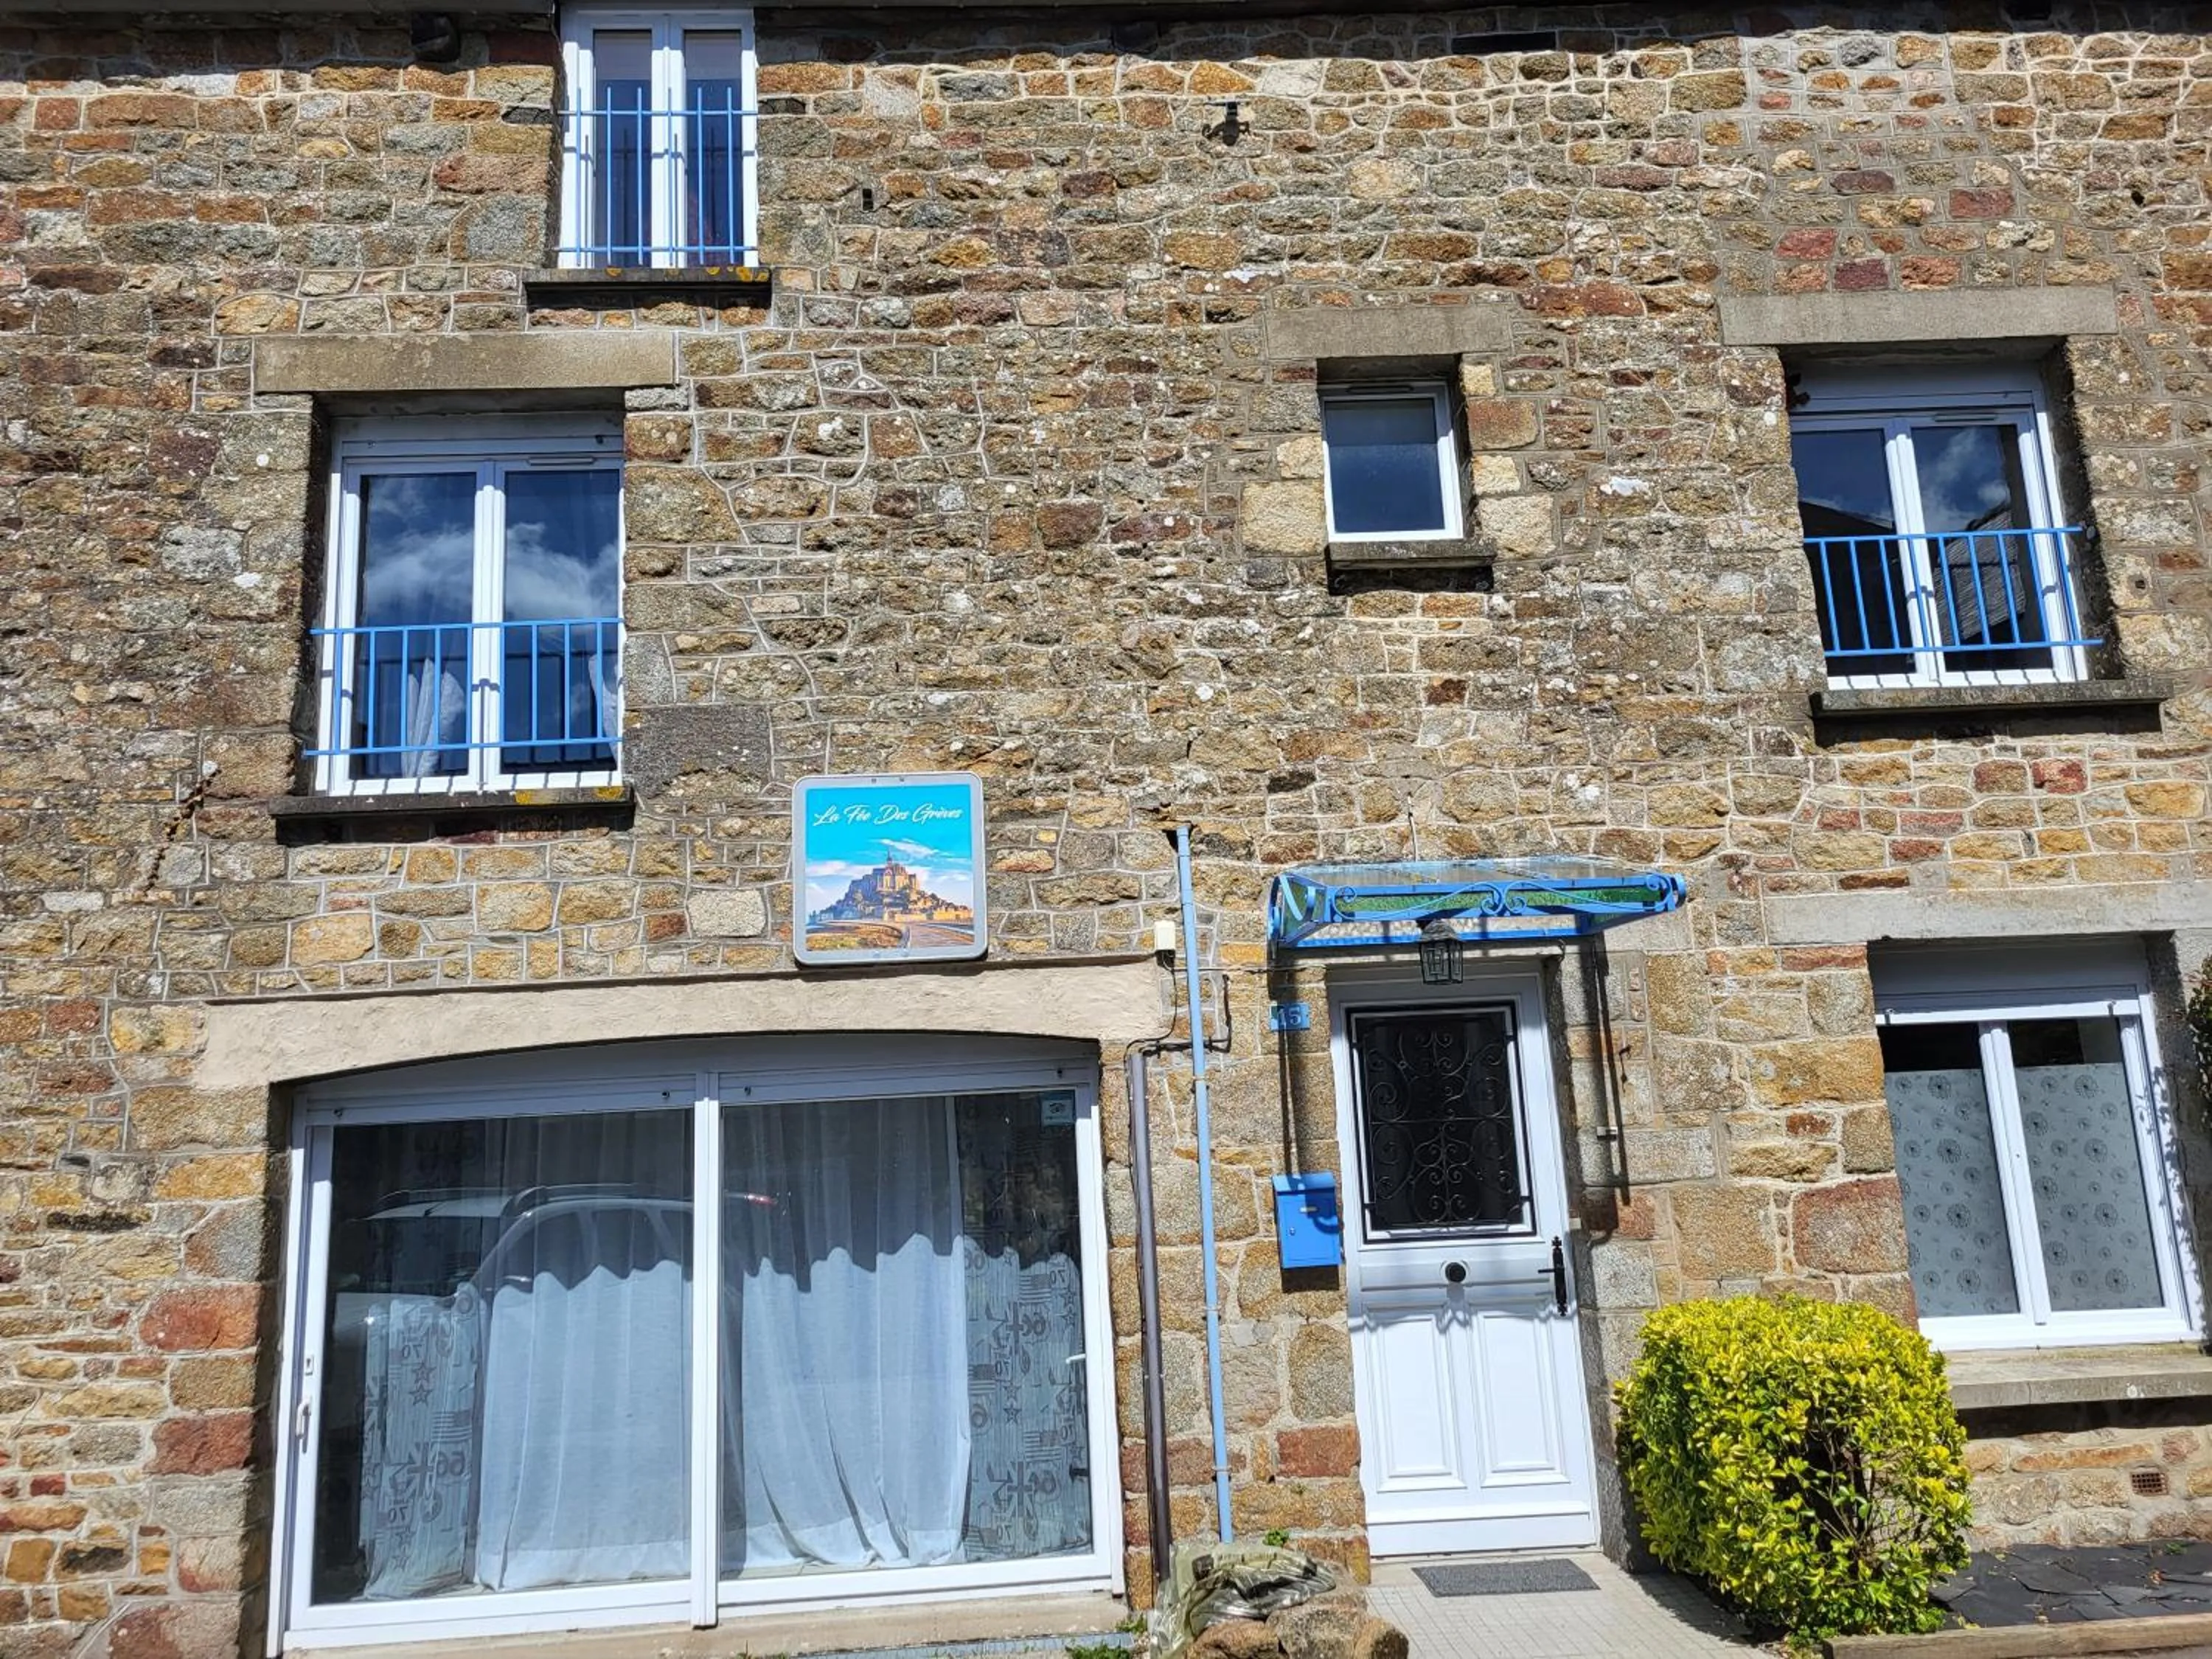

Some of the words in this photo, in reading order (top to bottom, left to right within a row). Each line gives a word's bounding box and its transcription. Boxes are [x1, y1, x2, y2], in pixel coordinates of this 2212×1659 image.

[813, 804, 839, 826] La
[874, 804, 909, 825] Des
[1278, 1007, 1301, 1025] 15
